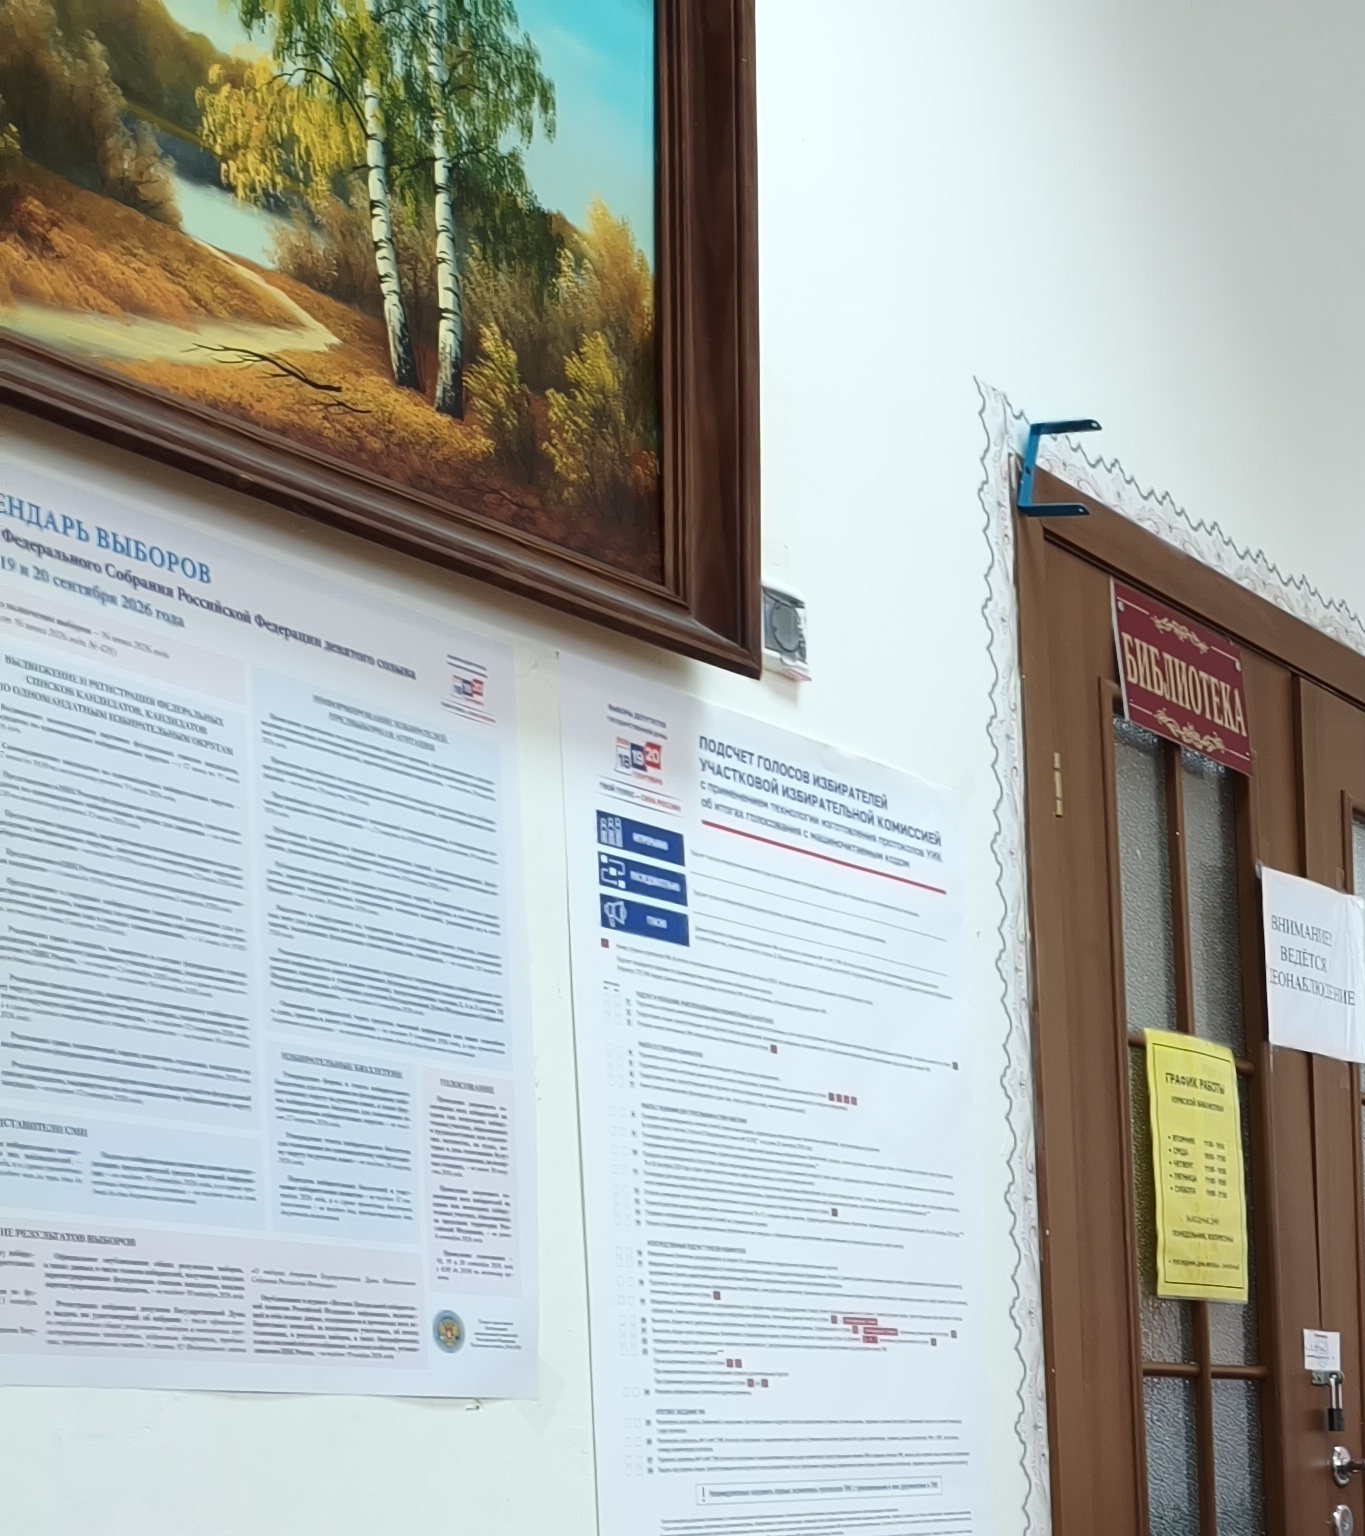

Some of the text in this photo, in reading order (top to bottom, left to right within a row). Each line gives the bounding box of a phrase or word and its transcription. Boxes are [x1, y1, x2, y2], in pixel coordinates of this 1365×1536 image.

[1, 528, 101, 575] Федерального
[105, 563, 173, 599] Собрания
[178, 586, 251, 624] Российской
[254, 614, 322, 647] Федерации
[34, 566, 49, 582] 20
[95, 526, 212, 584] ВЫБОРОВ
[1121, 631, 1247, 737] БИБЛИОТЕКА
[699, 735, 888, 809] ПОДСЧЕТ ГОЛОСОВ ИЗБИРАТЕЛЕЙ
[699, 757, 942, 847] УЧАСТКОВОЙ ИЗБИРАТЕЛЬНОЙ КОМИССИЕЙ
